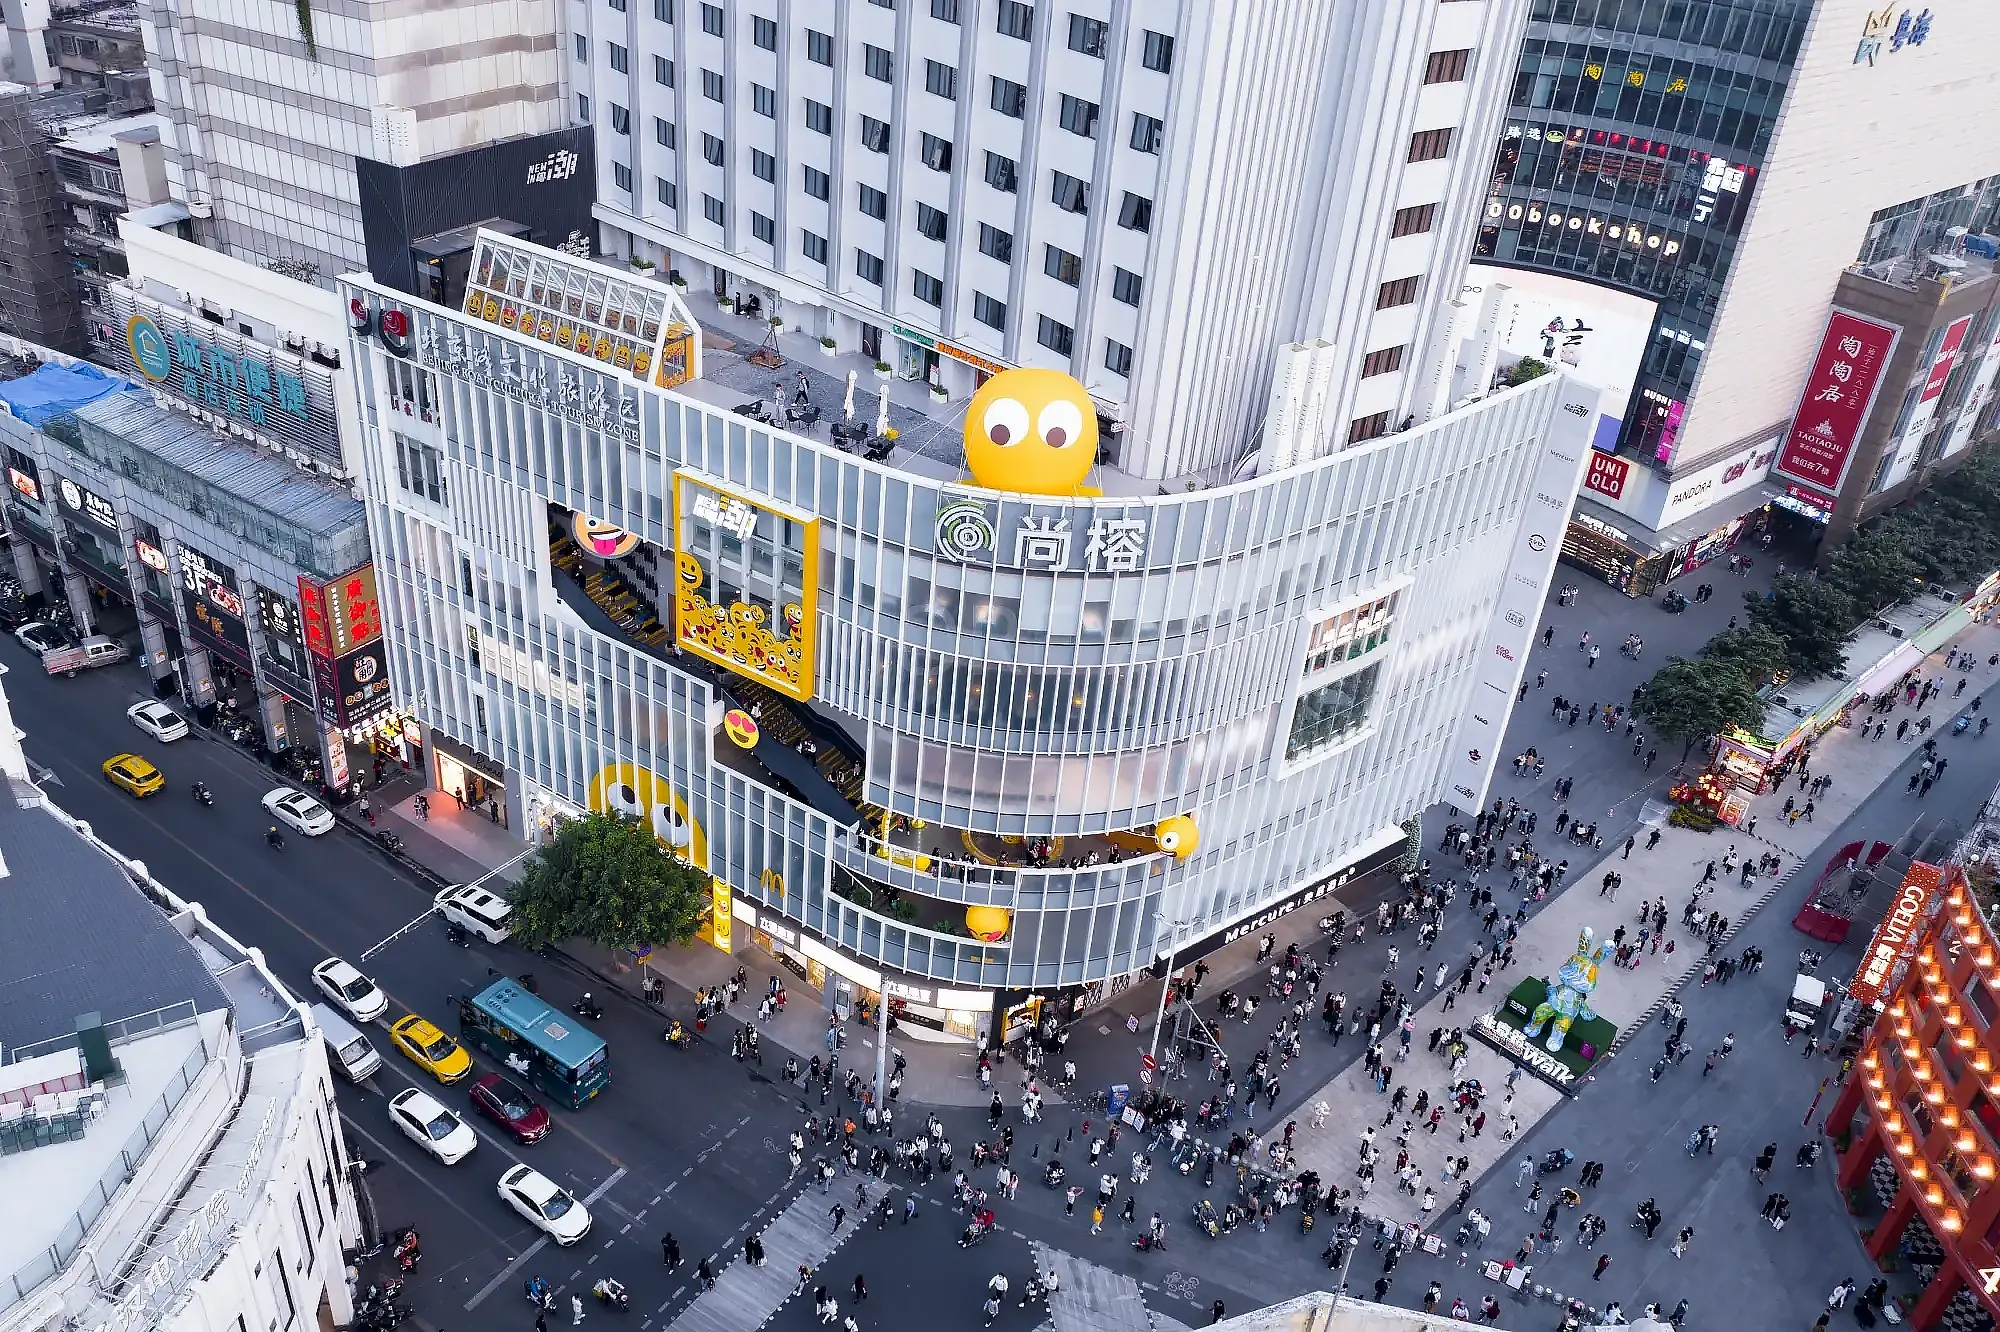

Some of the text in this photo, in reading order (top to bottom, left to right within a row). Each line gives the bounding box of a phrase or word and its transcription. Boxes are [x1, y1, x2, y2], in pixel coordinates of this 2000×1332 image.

[1585, 63, 1688, 93] 陶陶居
[172, 328, 309, 421] 城市便捷
[1814, 335, 1863, 403] 陶陶居
[422, 353, 639, 441] BEIJING ROAD CULTURAL TOURISM ZONE
[1798, 430, 1843, 453] TAOTAOJU
[1590, 472, 1620, 493] QLO
[1595, 457, 1621, 479] UNI
[1672, 479, 1713, 507] PANDORA
[1014, 515, 1147, 572] 尚榕
[183, 565, 207, 595] 3F
[1224, 900, 1294, 944] Mercure
[1882, 885, 1925, 943] GOELIA
[1521, 1045, 1576, 1084] Walk
